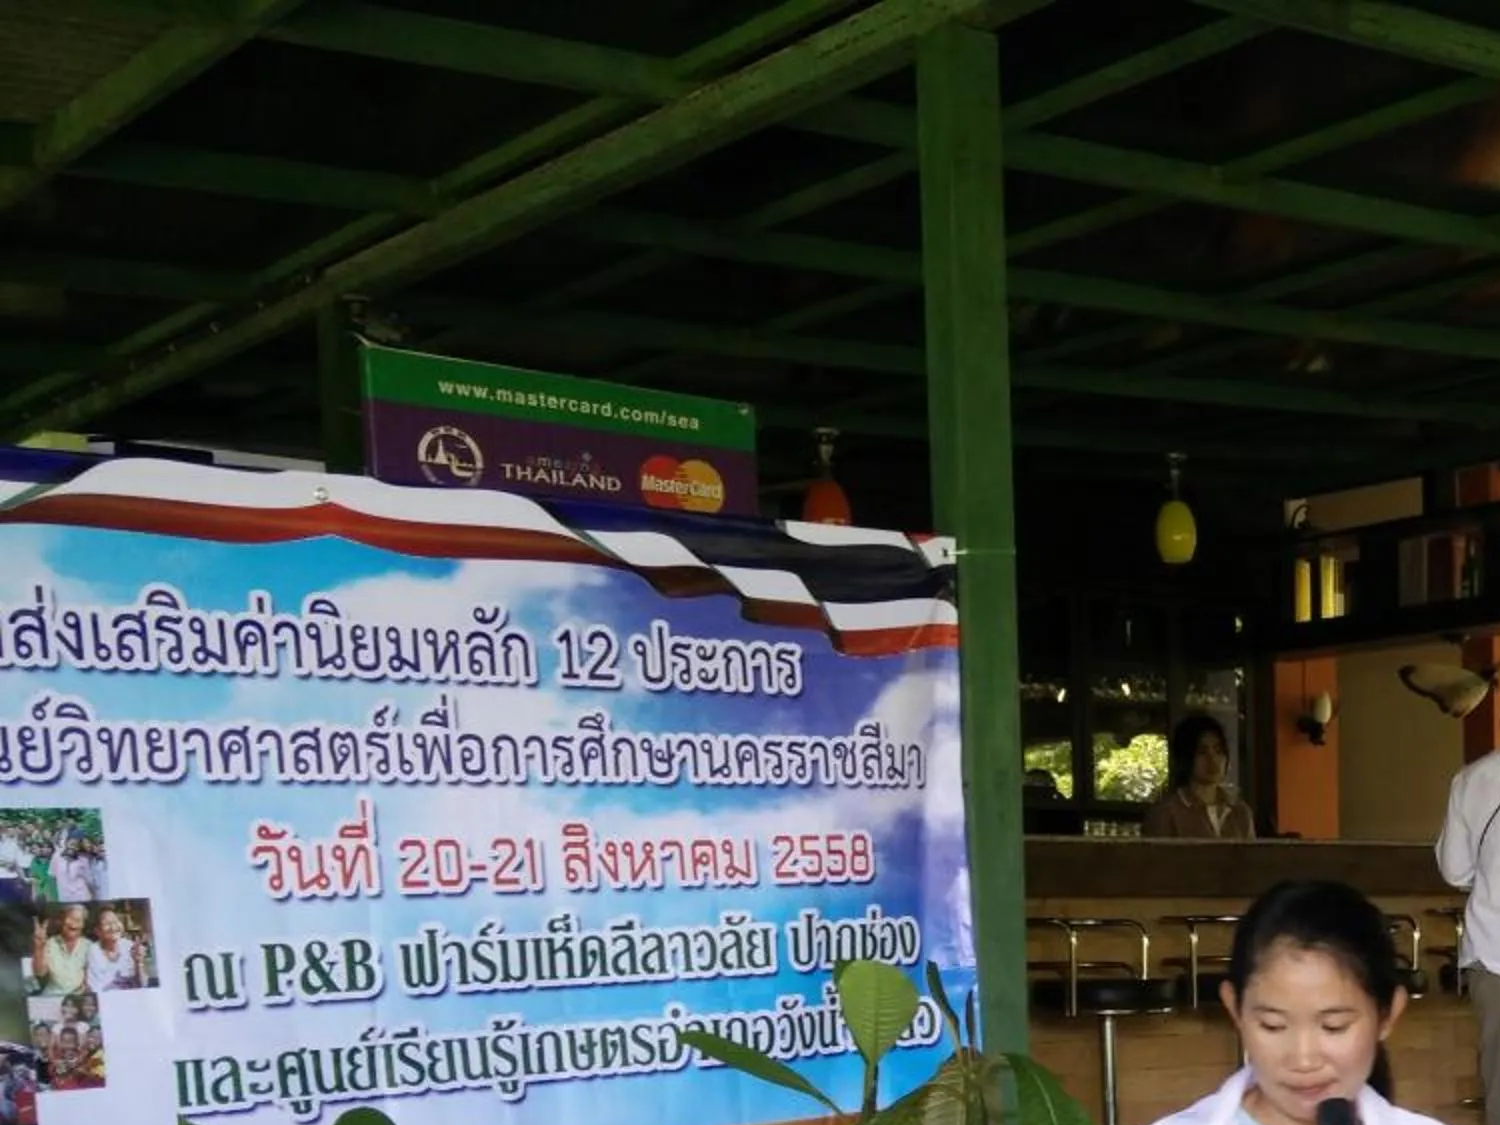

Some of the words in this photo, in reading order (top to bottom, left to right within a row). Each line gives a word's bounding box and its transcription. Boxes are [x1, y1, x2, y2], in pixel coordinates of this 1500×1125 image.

[437, 377, 700, 431] www.mastercard.com/sea
[500, 462, 622, 493] THAILAND
[640, 472, 722, 500] MasterCard
[0, 584, 523, 681] ส่งเสริมค่านิยมหลัก
[557, 629, 617, 682] 12
[635, 625, 800, 691] ประการ
[251, 799, 373, 890] วันที่
[398, 837, 538, 888] 20-21
[562, 822, 752, 883] สิงหาคม
[773, 833, 870, 879] 2558
[183, 951, 238, 1002] ณ
[260, 938, 376, 997] P&B
[399, 913, 774, 989] ฟาร์มเห็ดลีลาวลัย
[788, 909, 917, 966] ปากช่อง
